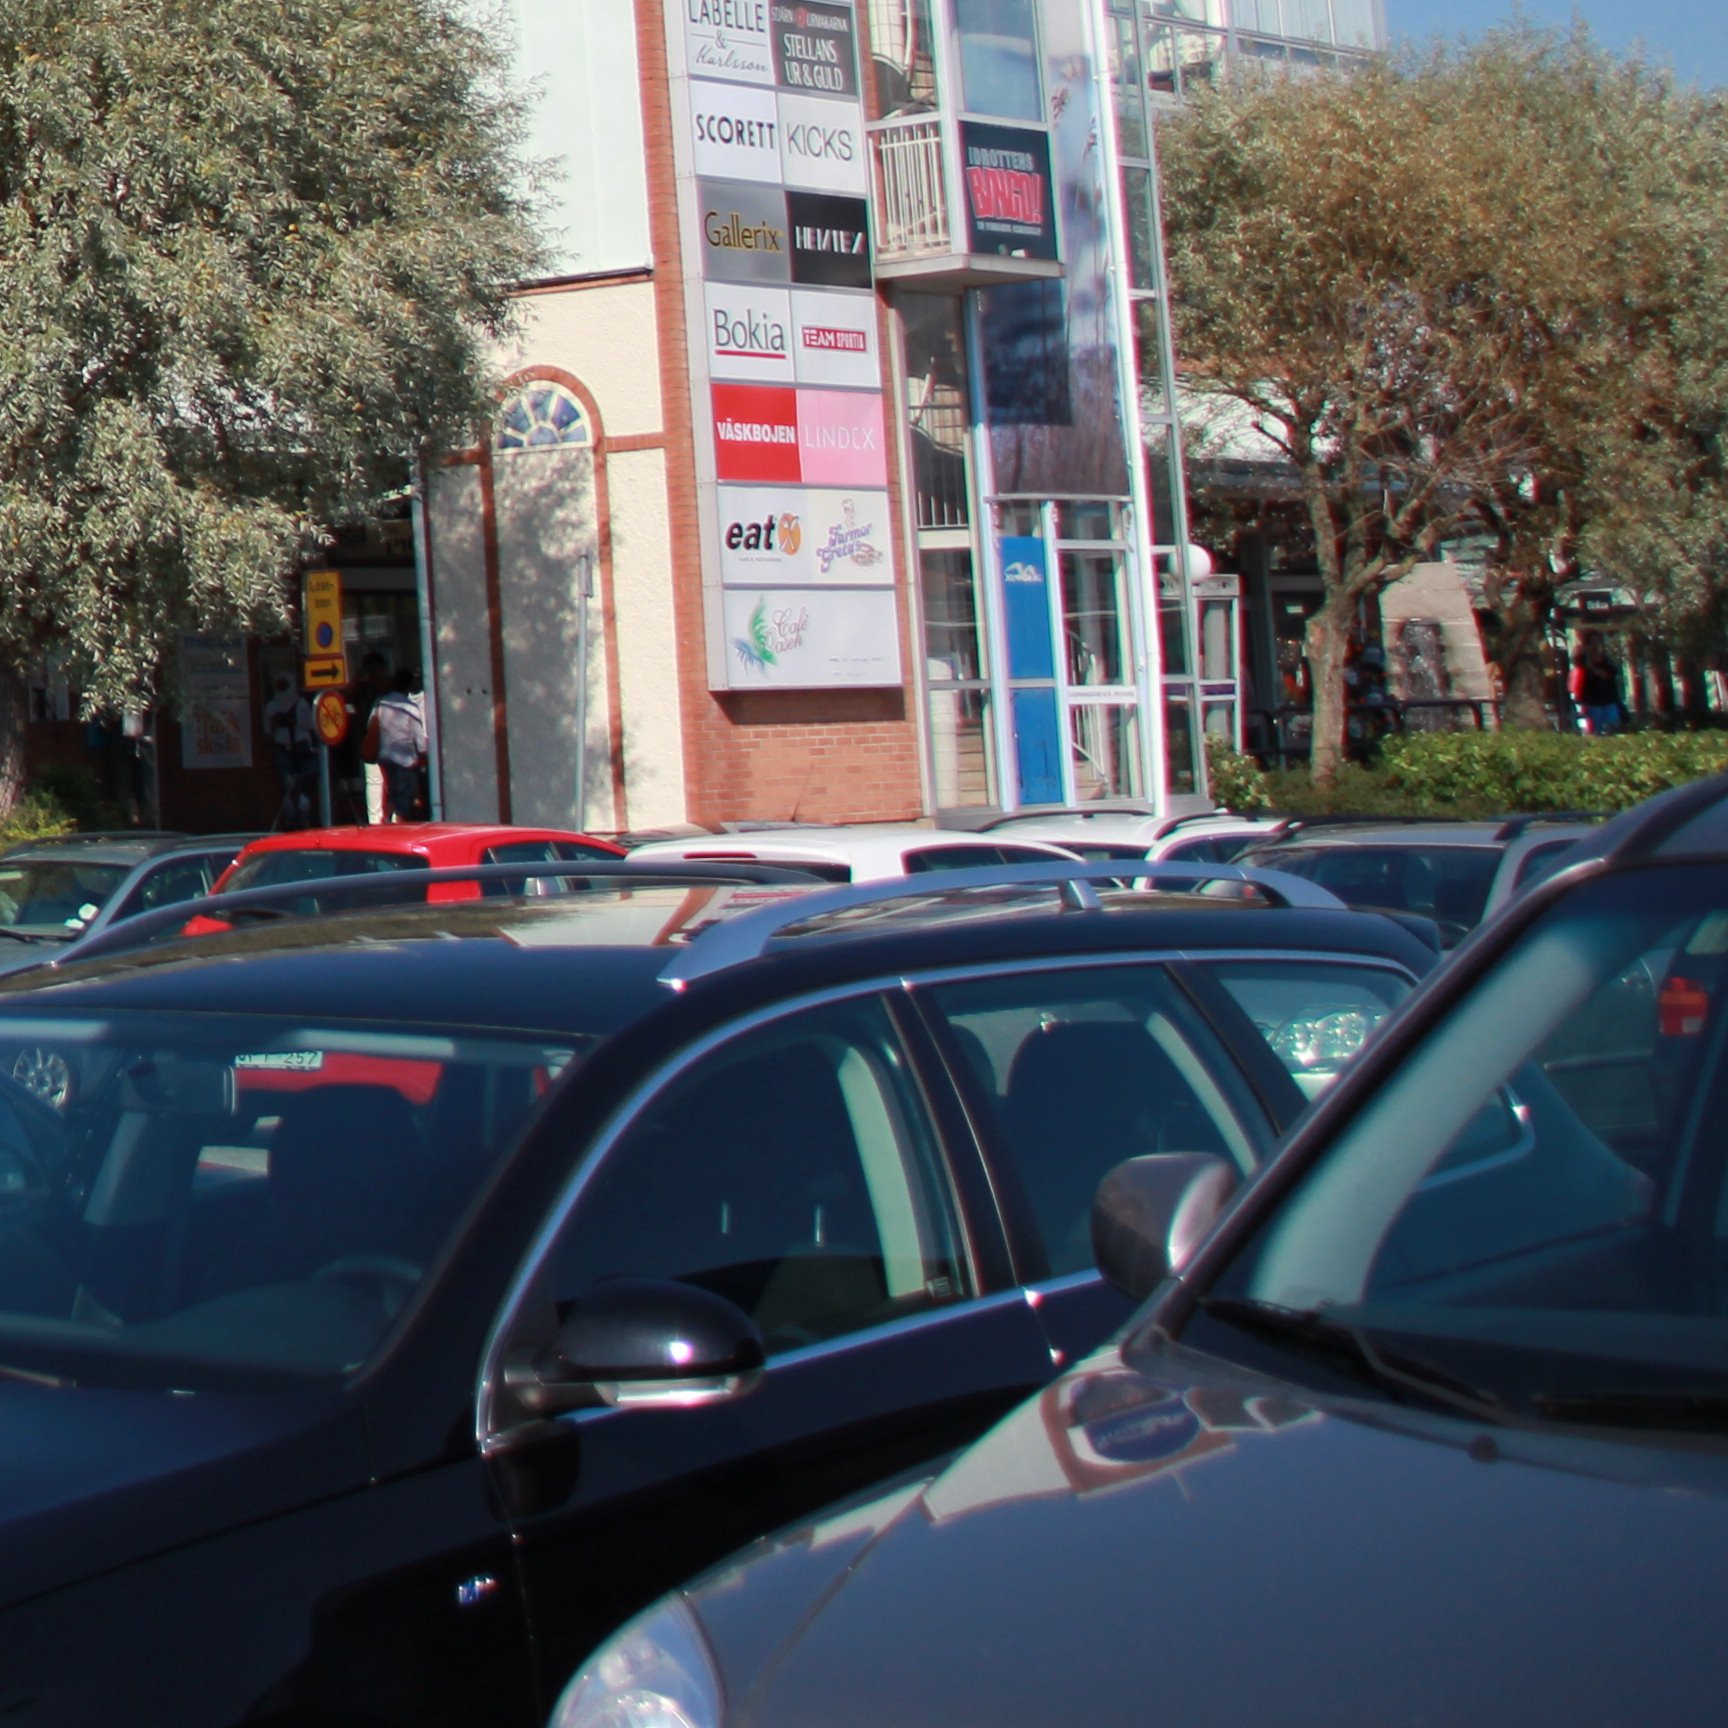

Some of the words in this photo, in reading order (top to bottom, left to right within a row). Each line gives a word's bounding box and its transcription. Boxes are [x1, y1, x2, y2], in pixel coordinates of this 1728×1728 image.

[715, 30, 727, 49] &
[784, 33, 837, 63] STELLANS
[696, 43, 768, 72] Karlsson
[785, 61, 800, 85] UR
[802, 63, 813, 86] &
[813, 63, 843, 90] GULD
[696, 113, 775, 150] SCORETT
[786, 123, 853, 161] KICKS
[704, 211, 781, 252] Gallerix
[713, 308, 785, 351] Bokia
[803, 329, 836, 348] TEAM
[836, 332, 865, 350] SPORTIA
[717, 418, 796, 444] VÄSKBOJEN
[805, 424, 876, 450] LINDEX
[725, 515, 776, 551] eat
[828, 523, 873, 547] Farmor
